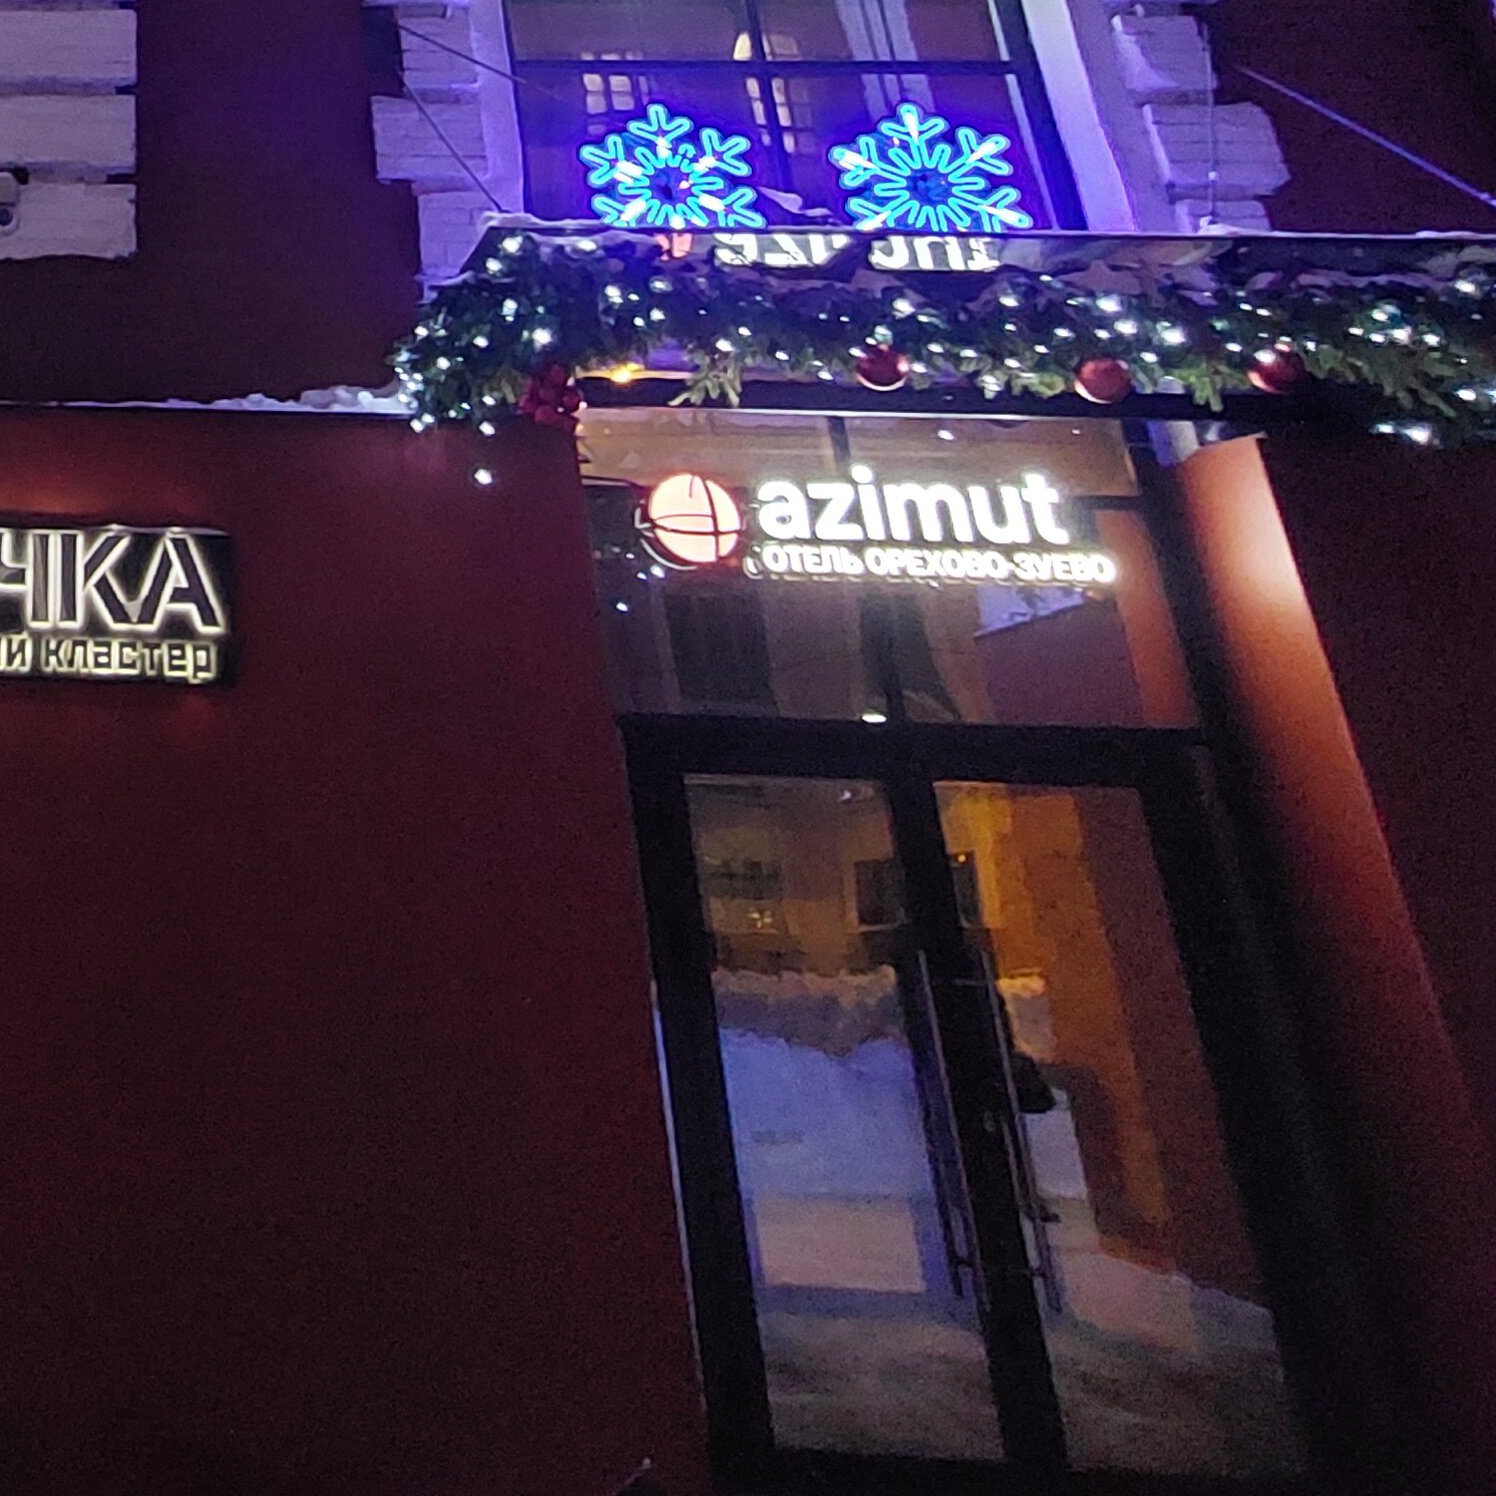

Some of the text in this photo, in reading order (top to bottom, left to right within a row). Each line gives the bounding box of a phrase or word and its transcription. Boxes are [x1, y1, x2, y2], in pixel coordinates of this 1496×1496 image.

[757, 464, 1070, 545] azimut
[762, 545, 1116, 583] ОТЕЛЬ ОРЕХОВО-ЗУЕВО
[42, 637, 217, 684] кластер
